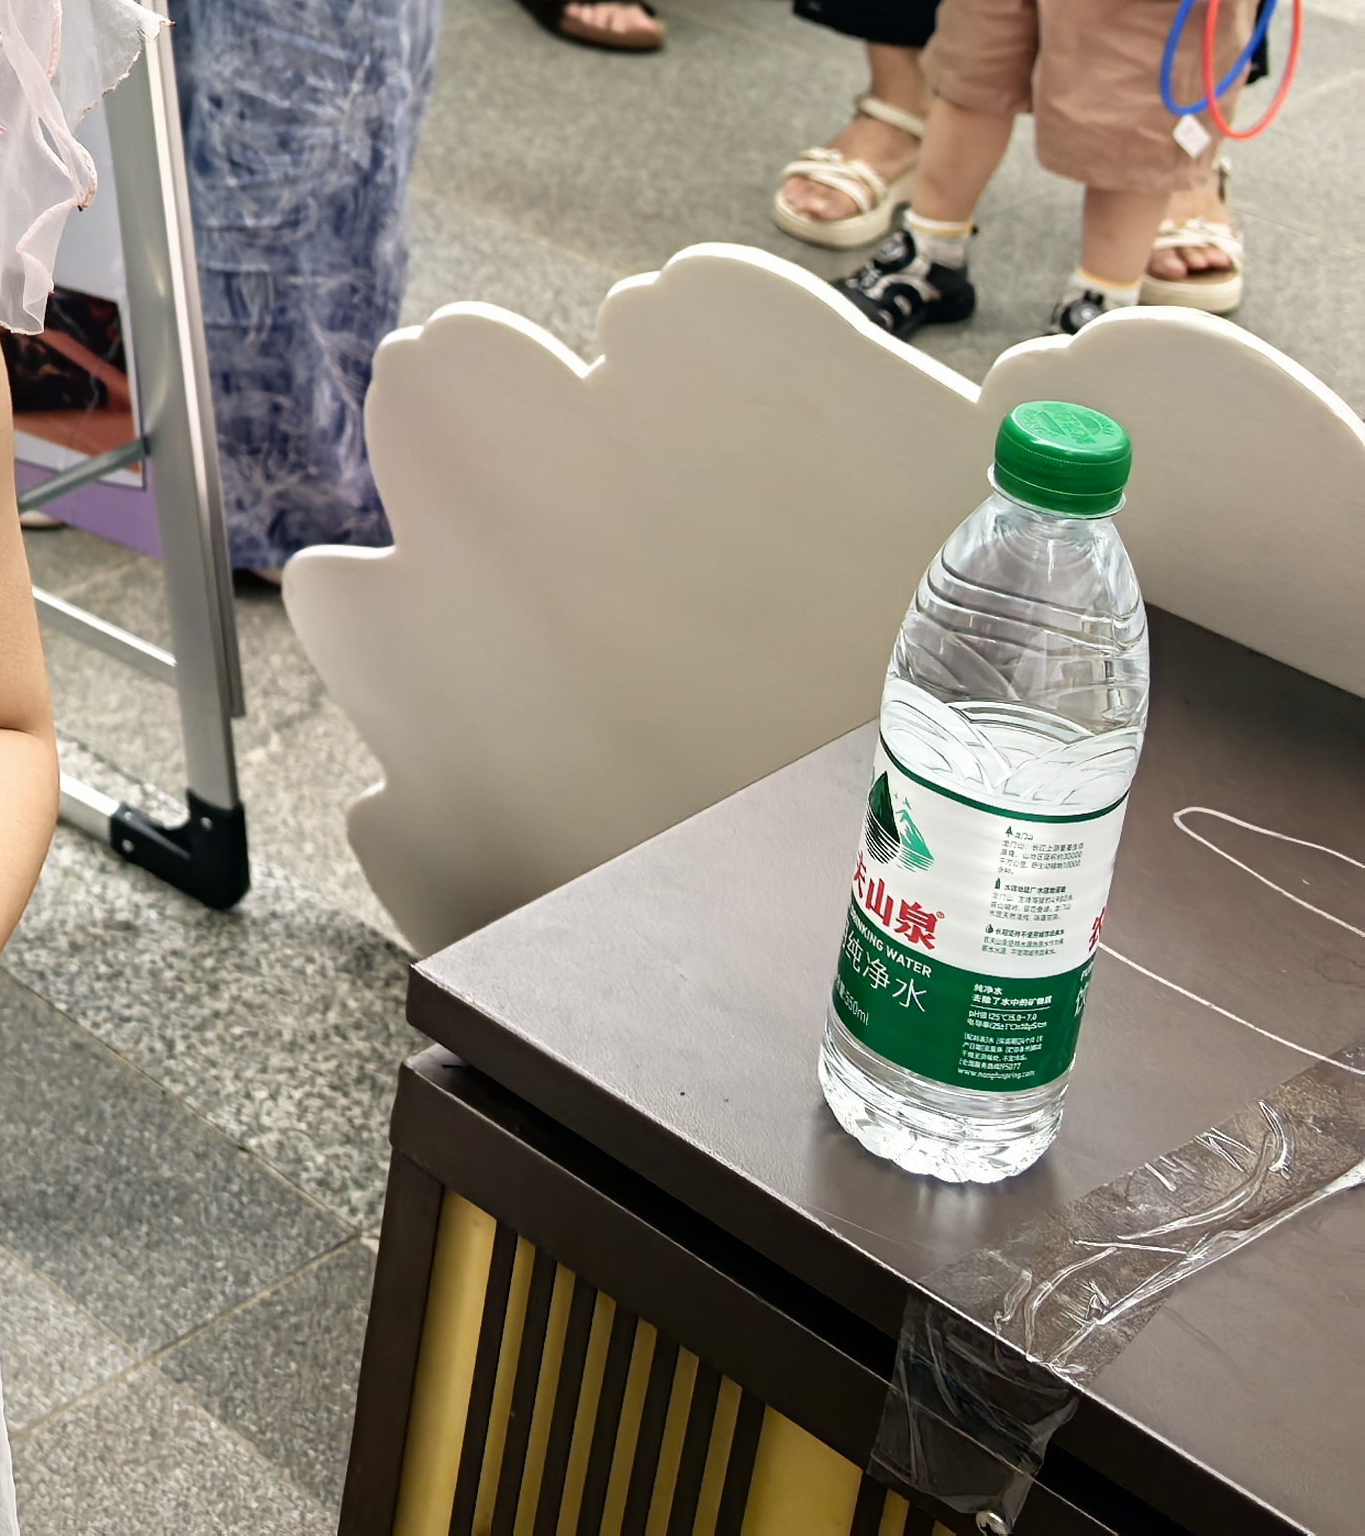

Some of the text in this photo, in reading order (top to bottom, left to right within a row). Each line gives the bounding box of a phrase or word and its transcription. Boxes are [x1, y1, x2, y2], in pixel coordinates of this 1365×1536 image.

[885, 944, 932, 978] WATER
[973, 983, 1003, 996] 纯净水
